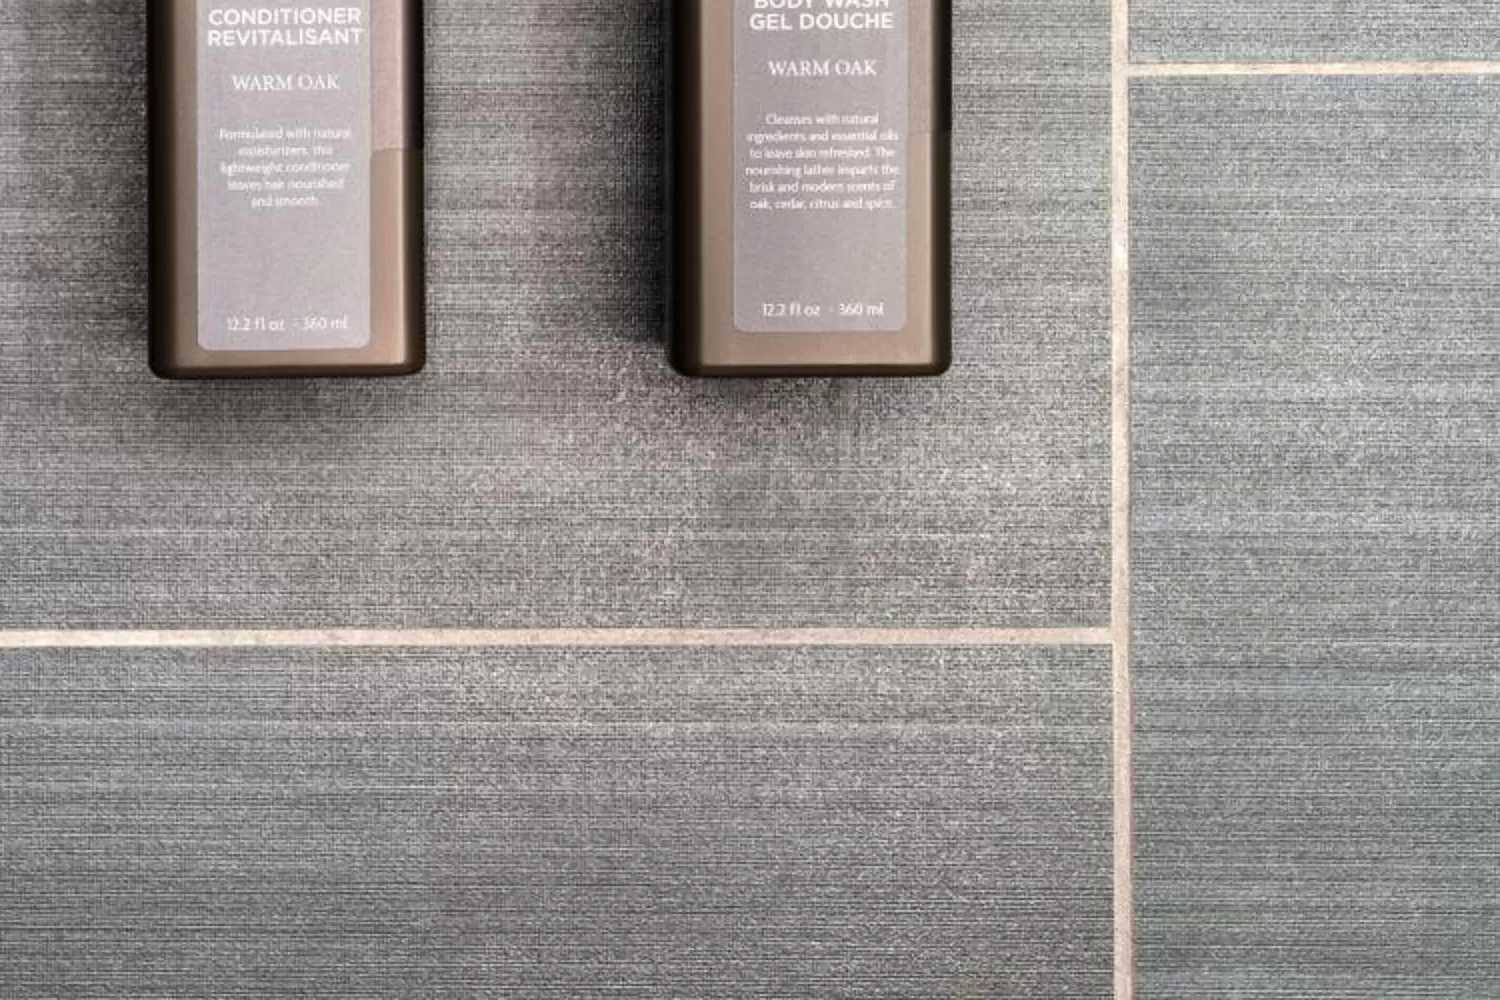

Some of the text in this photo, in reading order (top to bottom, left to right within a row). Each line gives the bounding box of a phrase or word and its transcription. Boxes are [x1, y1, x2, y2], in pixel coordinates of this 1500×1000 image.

[208, 7, 361, 25] CONDITIONER
[750, 12, 895, 30] GEL DOUCHE
[207, 28, 364, 47] REVITALISANT
[769, 60, 877, 77] WARM OAK
[232, 72, 340, 91] WARM OAK
[804, 306, 820, 317] oz
[839, 303, 863, 317] 360
[867, 302, 884, 316] ml
[303, 316, 328, 330] 360
[331, 315, 348, 329] ml
